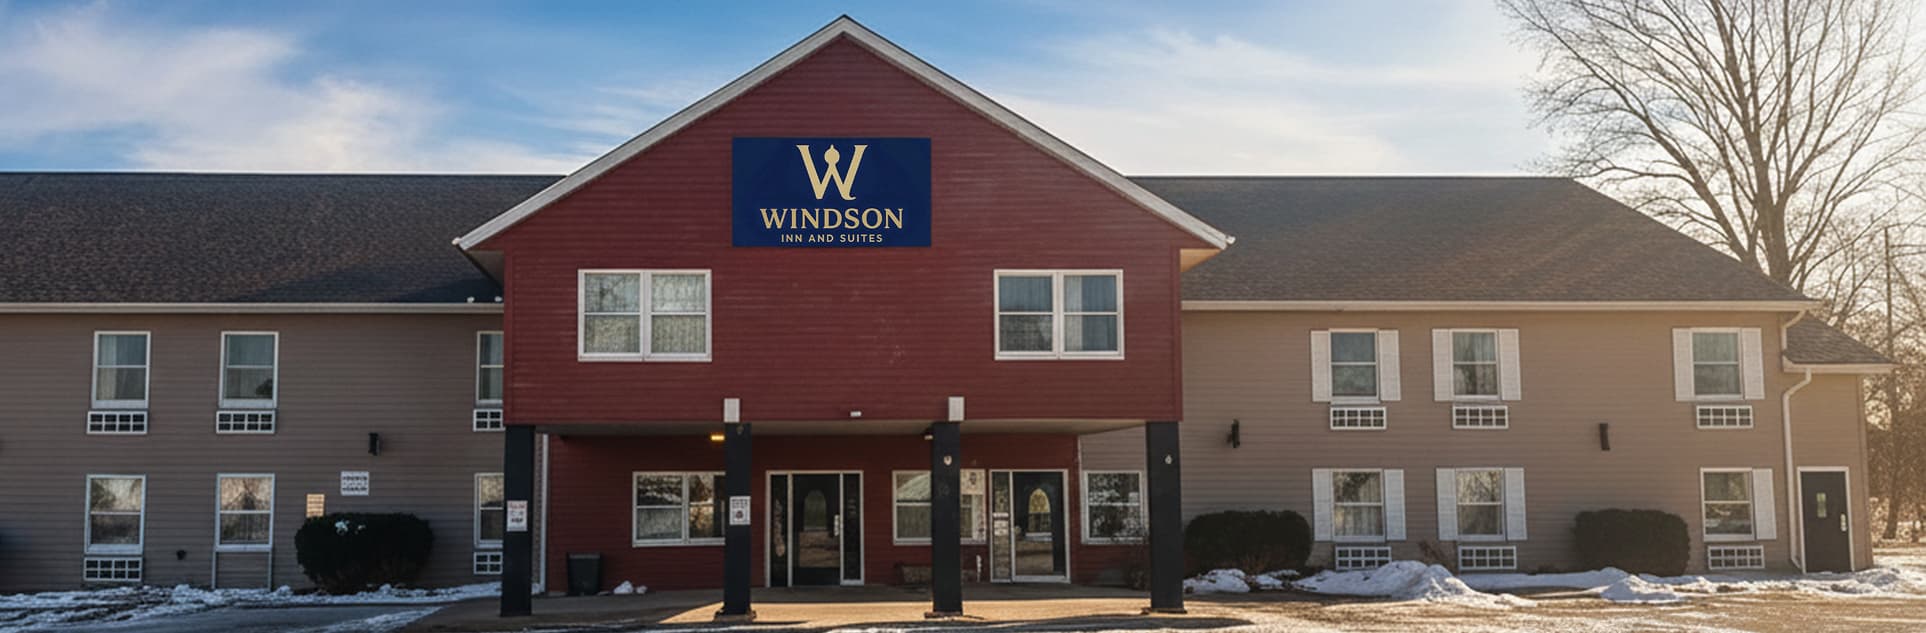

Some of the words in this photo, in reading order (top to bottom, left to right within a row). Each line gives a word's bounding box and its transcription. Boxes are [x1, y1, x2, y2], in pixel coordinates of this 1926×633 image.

[759, 208, 904, 229] WINDSON
[781, 234, 803, 243] INN
[808, 234, 834, 243] AND
[839, 234, 883, 243] SUITES
